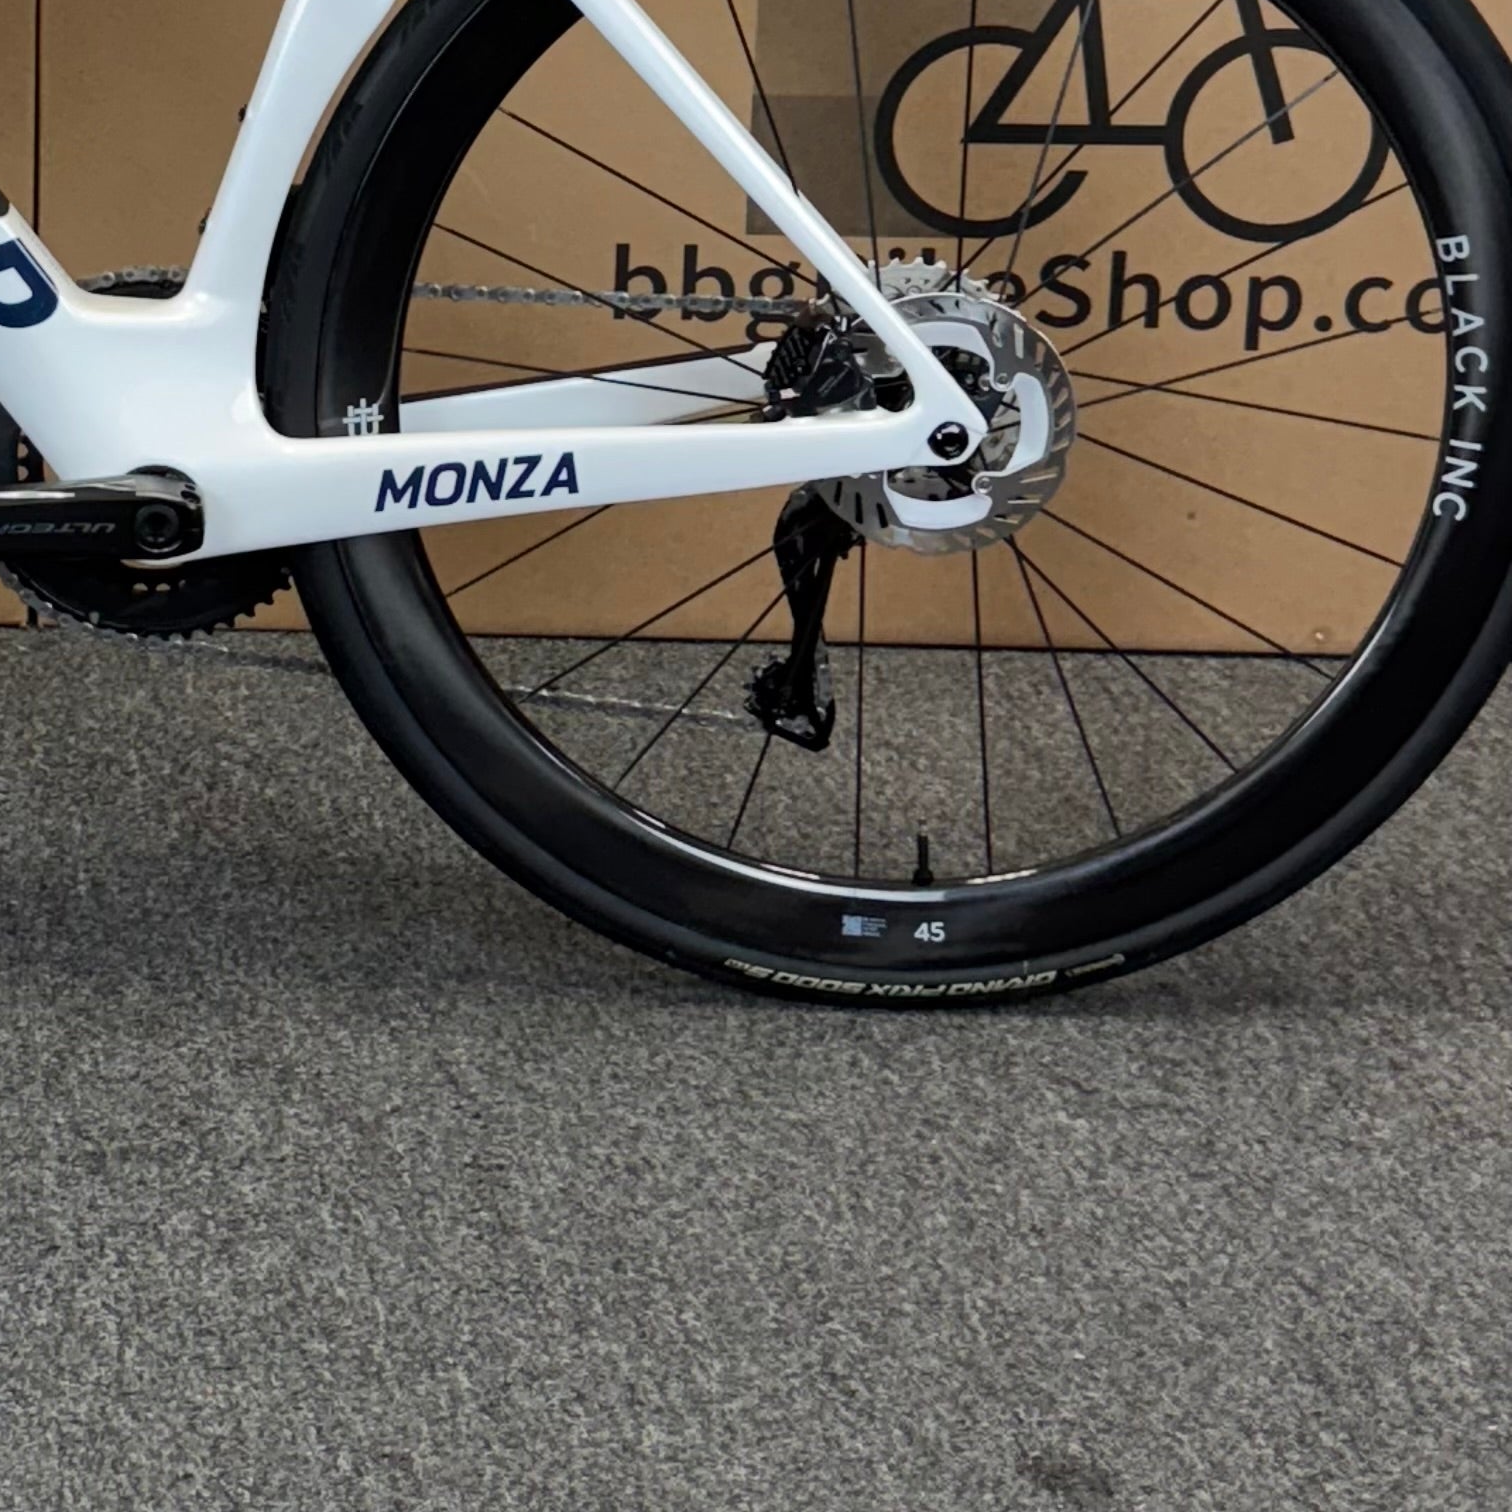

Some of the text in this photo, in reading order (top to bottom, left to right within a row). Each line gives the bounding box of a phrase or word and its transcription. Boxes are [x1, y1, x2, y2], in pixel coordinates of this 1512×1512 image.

[1432, 235, 1489, 522] BLACK INC
[375, 451, 580, 513] MONZA
[914, 921, 946, 943] 45
